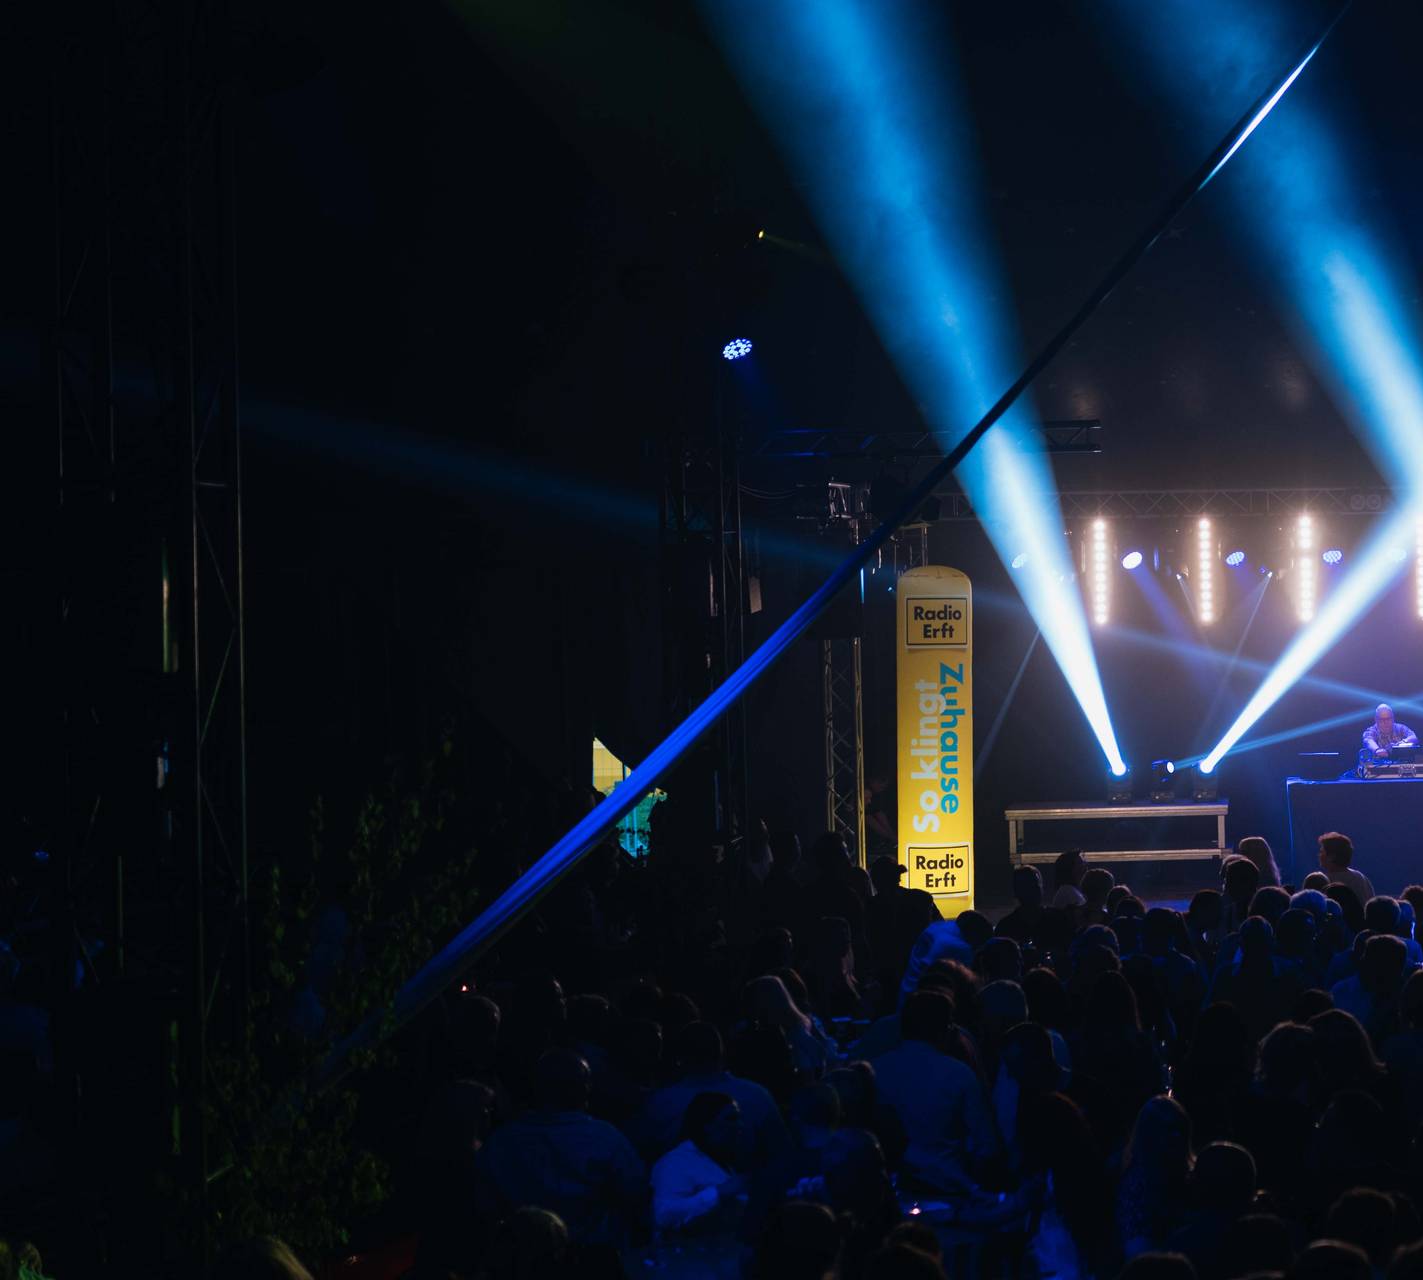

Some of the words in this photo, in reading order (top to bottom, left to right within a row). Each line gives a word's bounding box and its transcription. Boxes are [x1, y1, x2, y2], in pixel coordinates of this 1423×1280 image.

[913, 604, 962, 621] Radio
[922, 622, 955, 639] Erft
[910, 679, 947, 780] klingt
[940, 663, 965, 814] Zuhause
[912, 790, 940, 833] So
[915, 853, 964, 870] Radio
[925, 873, 957, 888] Erft
